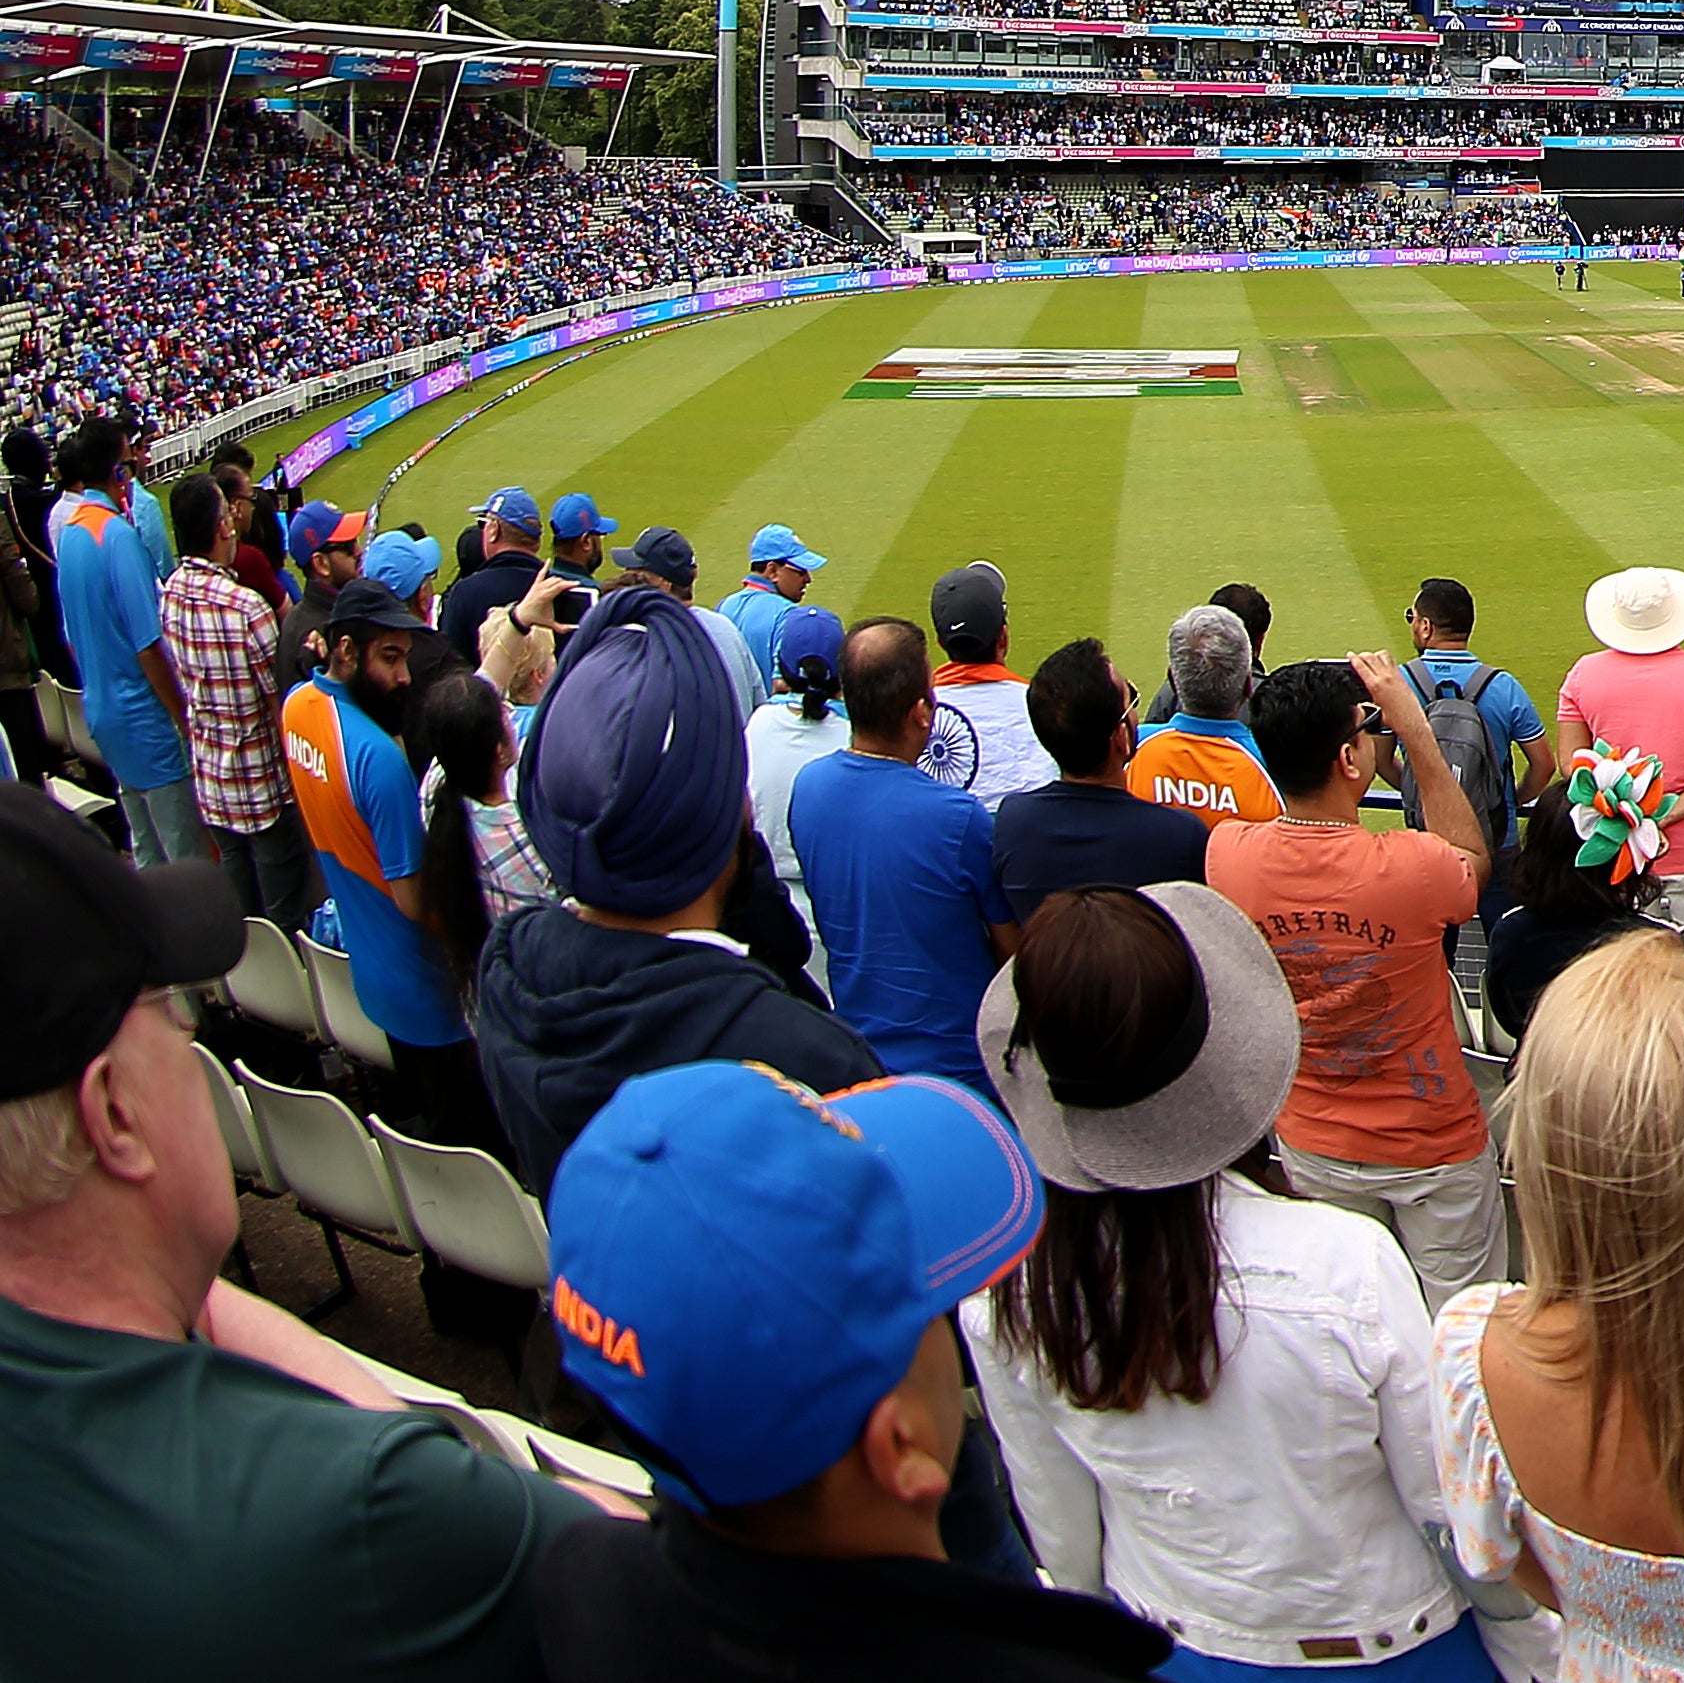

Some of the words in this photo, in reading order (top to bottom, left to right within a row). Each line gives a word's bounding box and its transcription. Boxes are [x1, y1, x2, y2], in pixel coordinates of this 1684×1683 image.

[1324, 250, 1356, 263] unicef
[288, 730, 328, 783] INDIA
[1154, 776, 1239, 814] INDIA
[554, 1274, 646, 1378] INDIA
